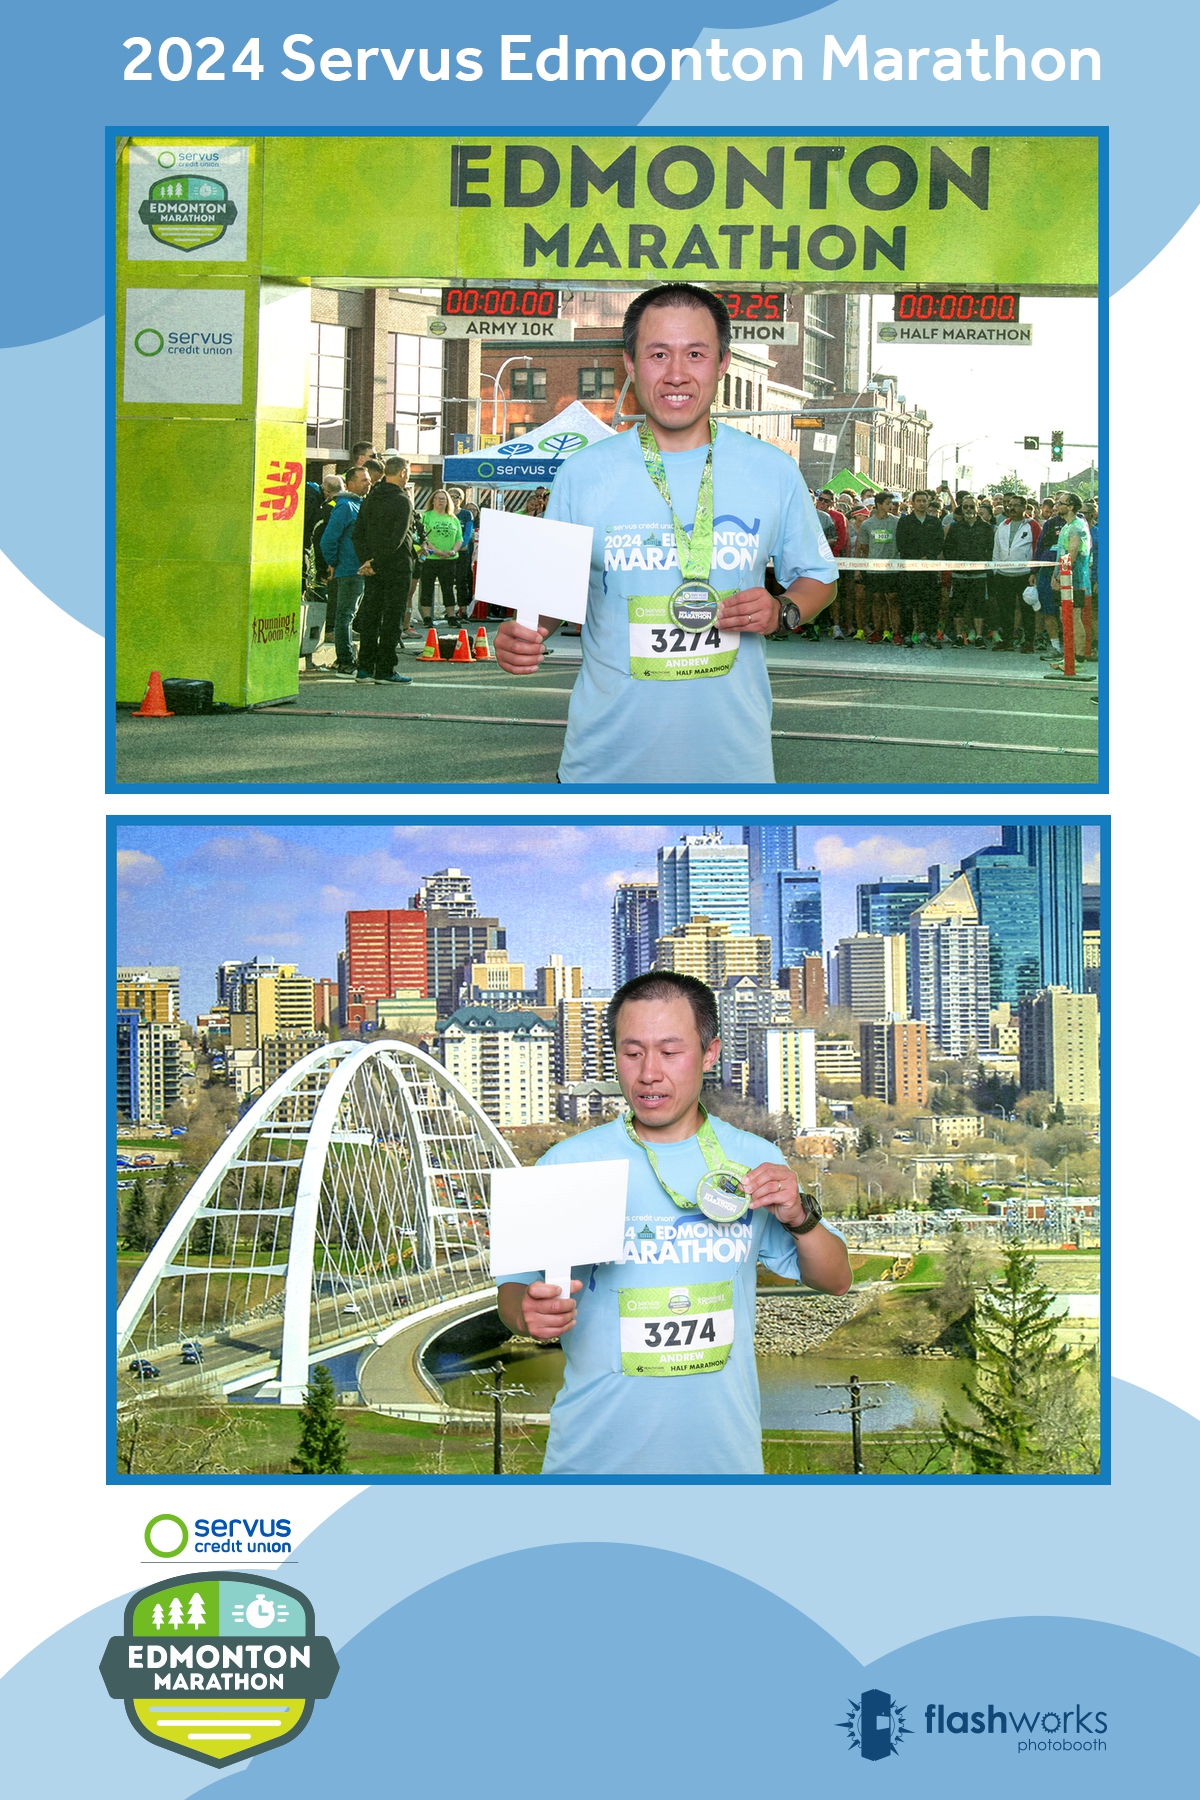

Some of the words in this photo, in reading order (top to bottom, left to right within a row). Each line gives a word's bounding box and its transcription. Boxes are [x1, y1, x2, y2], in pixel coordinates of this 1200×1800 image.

[178, 152, 220, 161] servus
[450, 144, 991, 211] EDMONTON
[149, 203, 227, 214] EDMONTON
[160, 214, 215, 222] MARATHON
[523, 223, 906, 271] MARATHON
[465, 321, 518, 336] ARMY
[521, 322, 554, 336] 10K
[730, 326, 784, 340] THON
[900, 328, 939, 340] HALF
[943, 328, 1031, 341] MARATHON
[168, 332, 233, 345] servus
[167, 345, 200, 355] credit
[202, 347, 233, 355] union
[496, 465, 545, 475] servus
[613, 523, 637, 531] servus
[638, 521, 659, 530] credit
[604, 534, 643, 549] 2024
[651, 628, 722, 653] 3274
[665, 657, 710, 669] ANDREW
[694, 664, 730, 675] MARATHON
[631, 1214, 653, 1222] credit
[656, 1223, 753, 1240] EDMONTON
[610, 1237, 752, 1265] ARATHON
[644, 1317, 716, 1348] 3274
[660, 1351, 705, 1363] ANDREW
[689, 1360, 724, 1371] MARATHON
